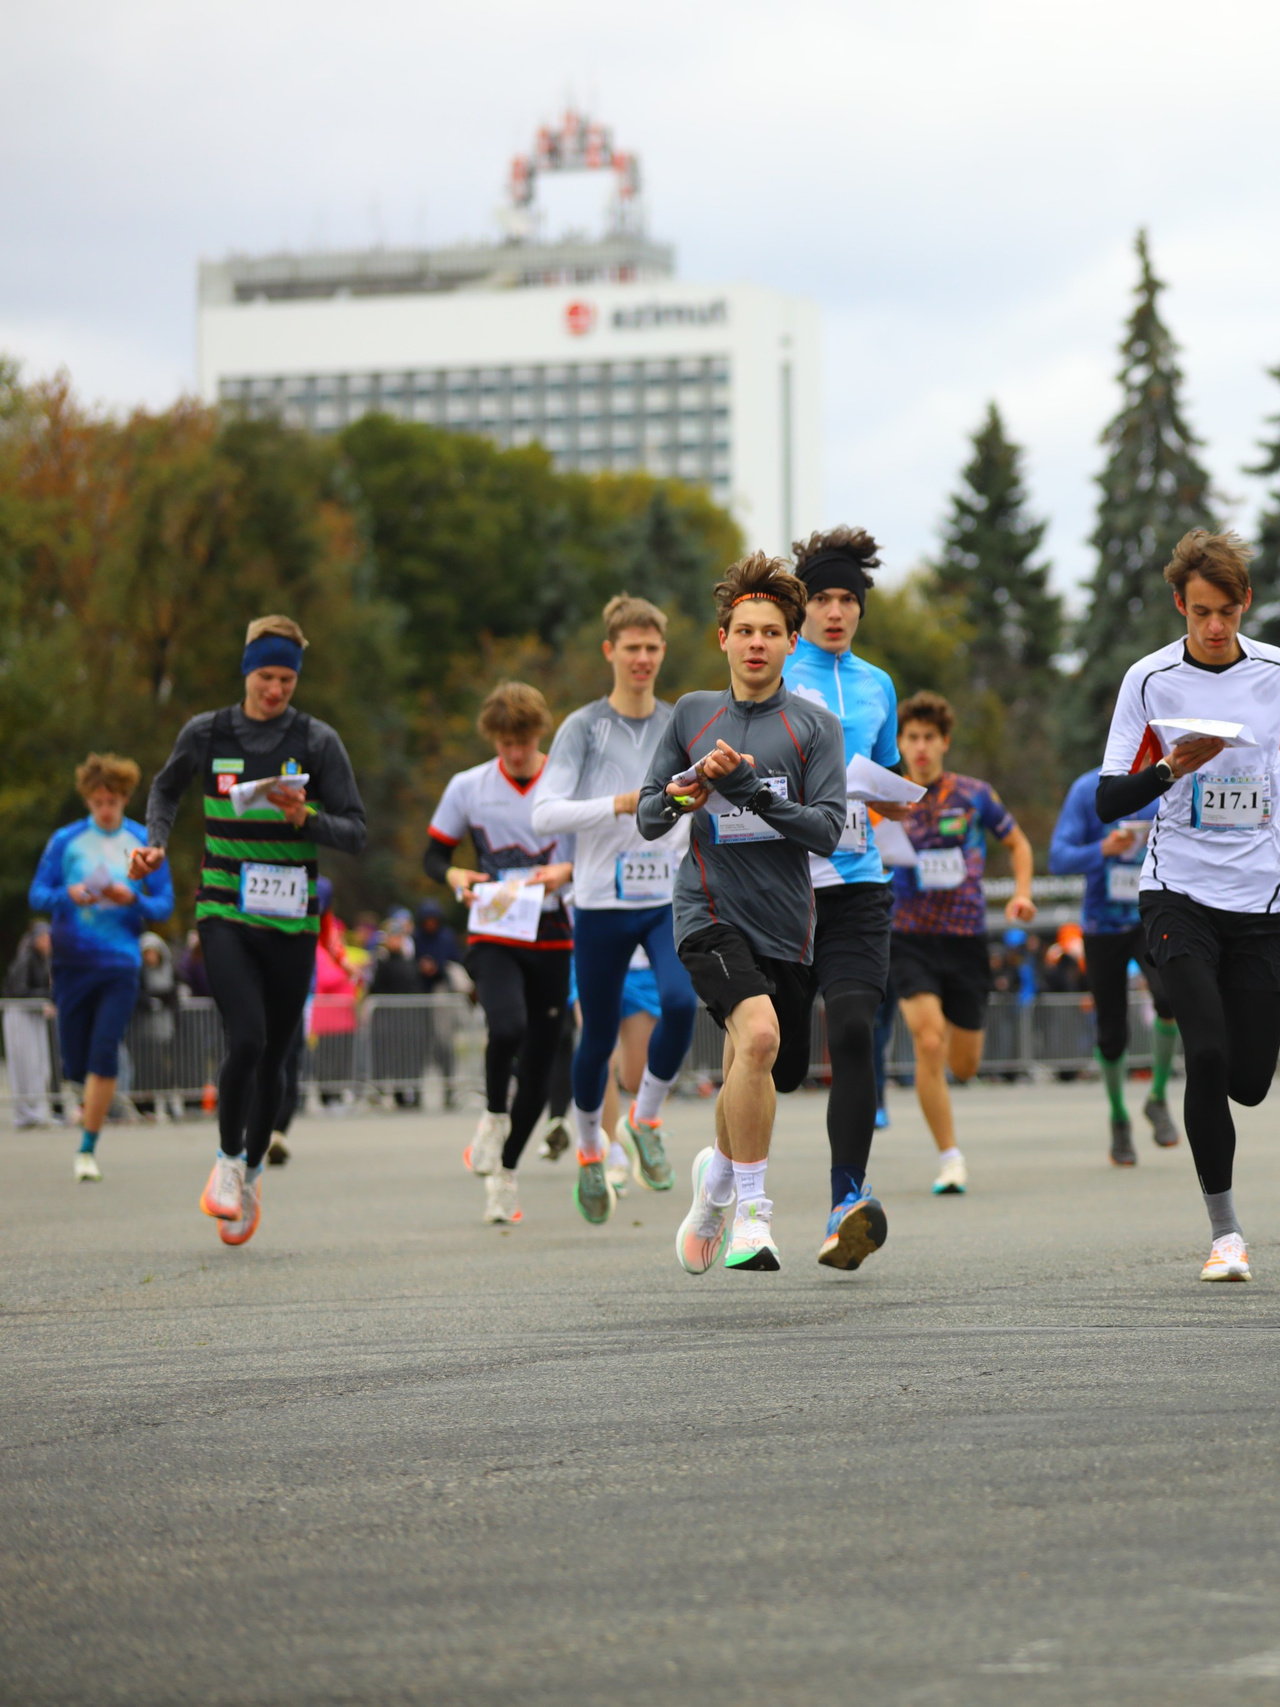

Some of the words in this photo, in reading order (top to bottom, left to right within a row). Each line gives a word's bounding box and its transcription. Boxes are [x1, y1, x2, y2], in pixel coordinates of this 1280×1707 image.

[1204, 790, 1258, 810] 217.1
[625, 863, 669, 880] 222.1
[249, 878, 296, 897] 227.1
